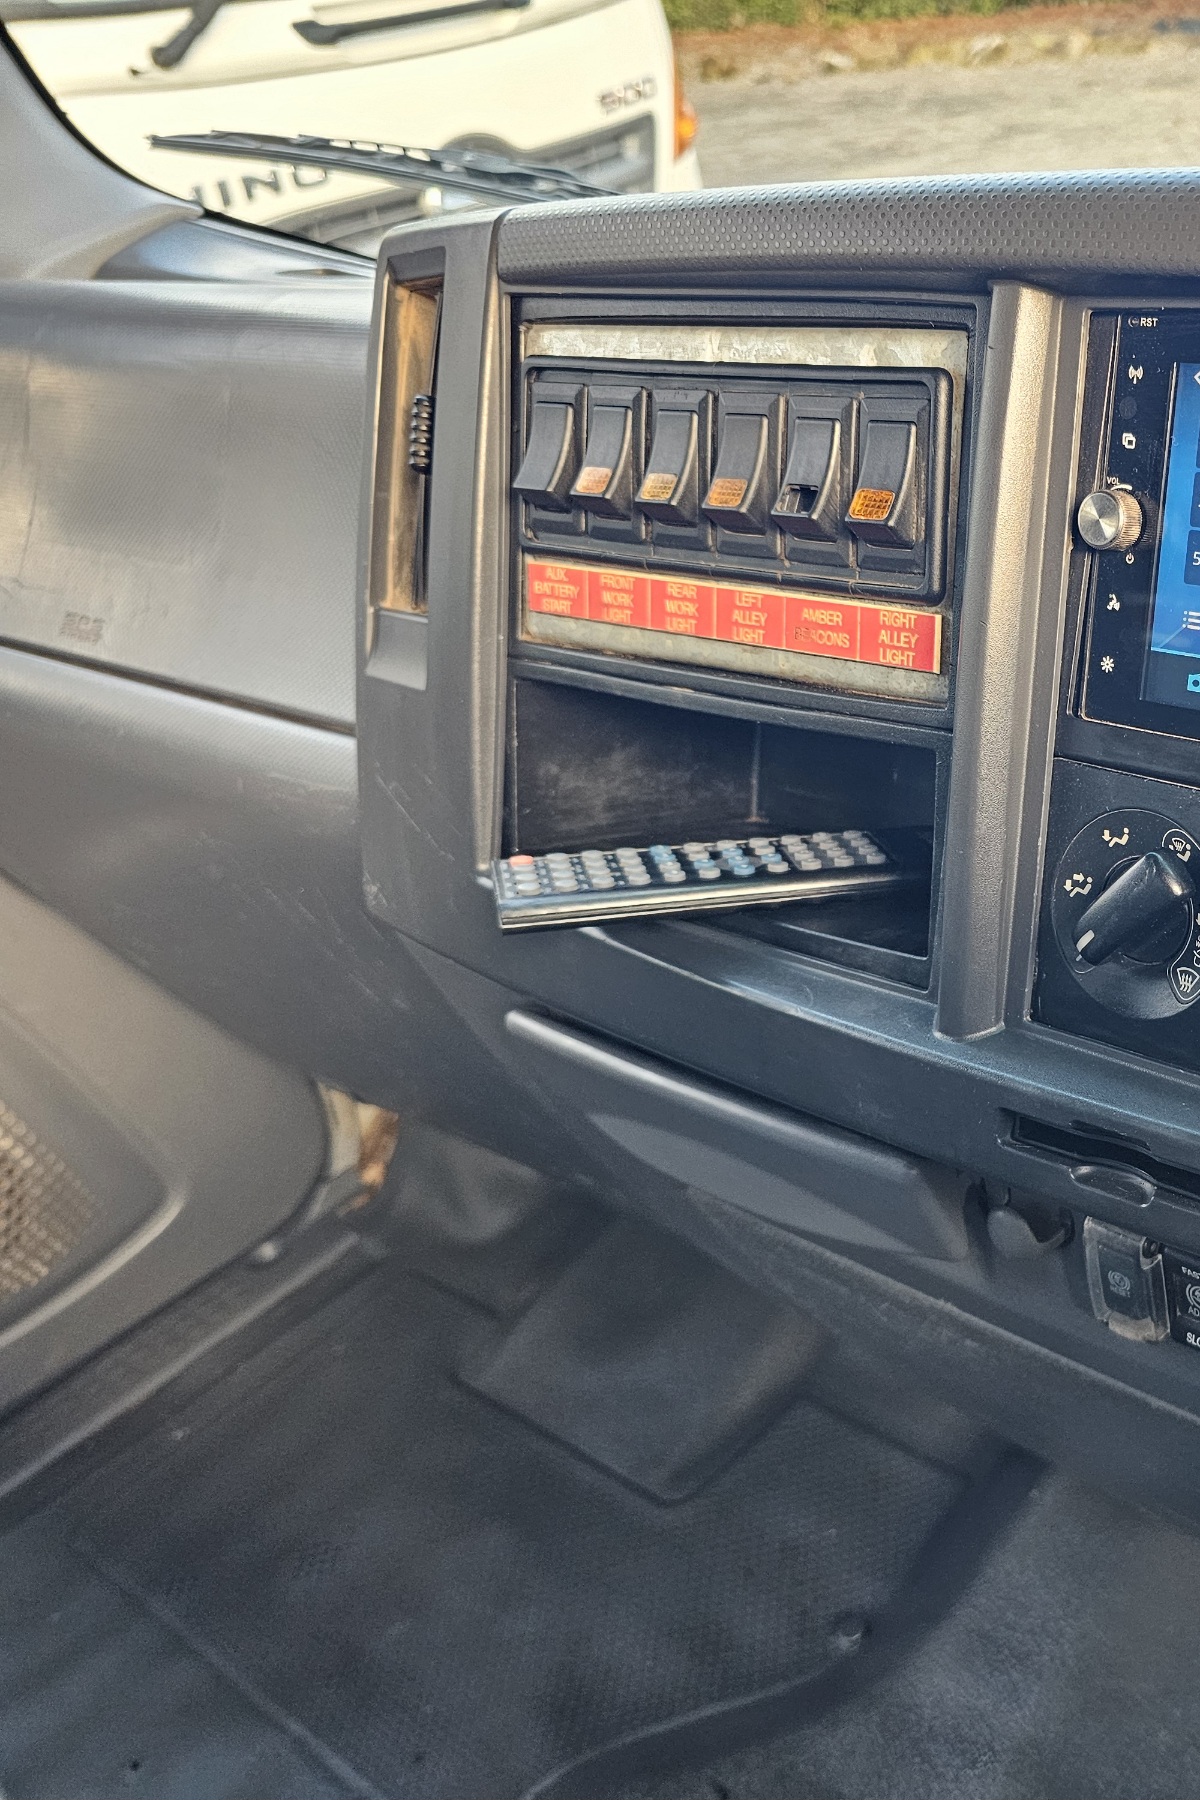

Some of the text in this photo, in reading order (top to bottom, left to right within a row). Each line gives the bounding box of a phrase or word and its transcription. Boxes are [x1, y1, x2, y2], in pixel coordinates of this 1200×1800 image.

[1140, 317, 1158, 327] RST
[1107, 476, 1120, 485] VOL
[533, 581, 580, 599] BATTERY
[601, 575, 635, 591] FRONT
[666, 583, 697, 599] REAR
[542, 598, 573, 615] START
[602, 591, 634, 608] WORK
[735, 592, 764, 608] LEFT
[603, 607, 633, 624] LIGHT
[665, 600, 699, 617] WORK
[802, 608, 843, 626] AMBER
[666, 616, 697, 634] LIGHT
[732, 610, 767, 627] ALLEY
[879, 611, 917, 630] RIGHT
[733, 626, 765, 644] LIGHT
[794, 626, 850, 649] BEACONS
[878, 629, 919, 648] ALLEY
[879, 649, 915, 667] LIGHT
